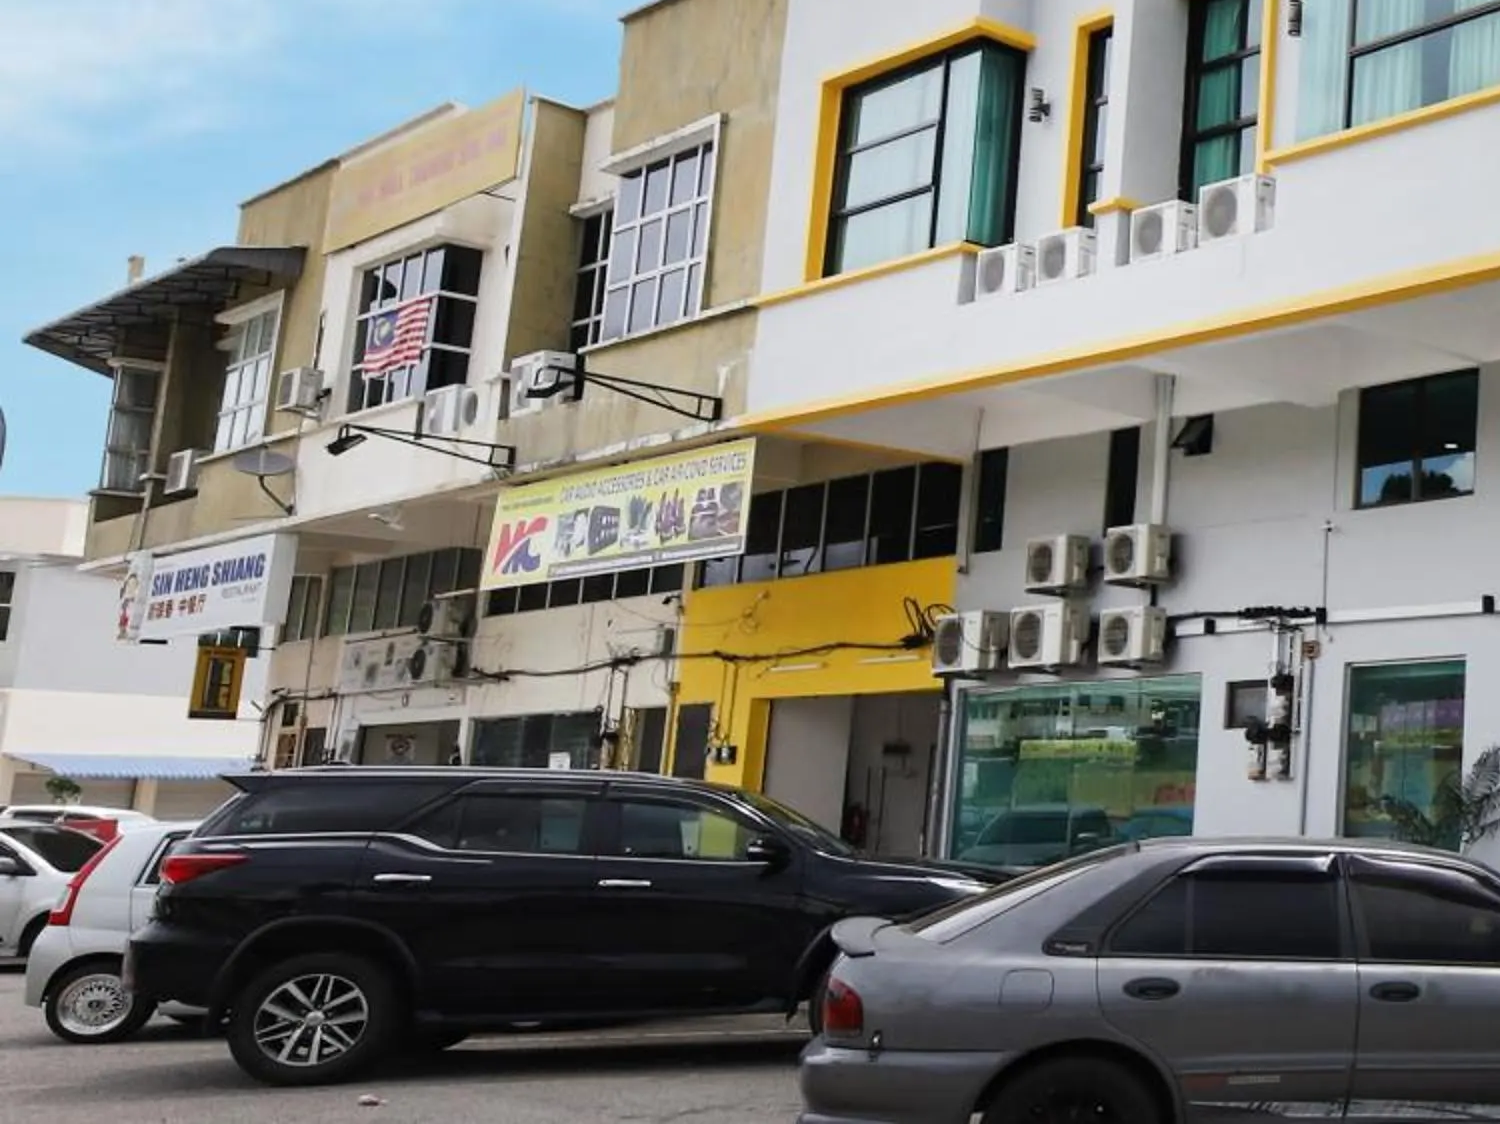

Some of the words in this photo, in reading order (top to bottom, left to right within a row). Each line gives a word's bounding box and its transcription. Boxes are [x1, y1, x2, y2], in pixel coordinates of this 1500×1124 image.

[152, 571, 174, 597] SIN
[174, 564, 211, 593] HENG
[211, 553, 266, 586] SHIANG
